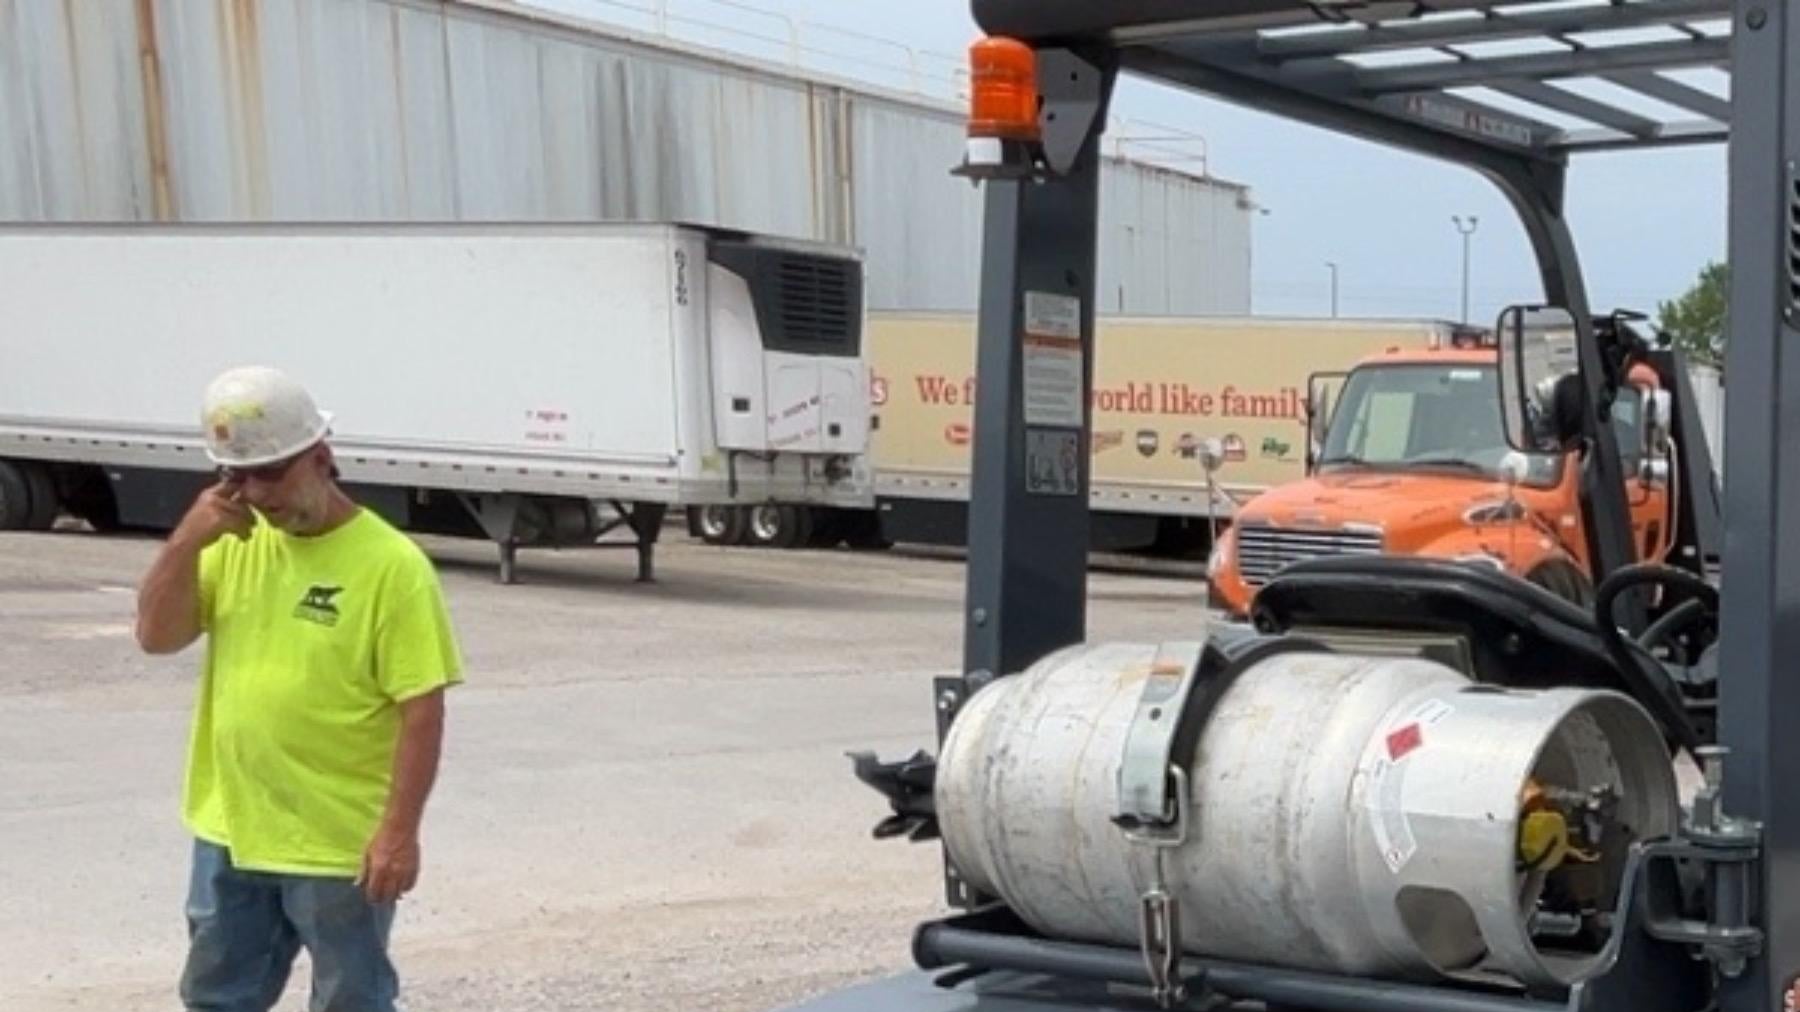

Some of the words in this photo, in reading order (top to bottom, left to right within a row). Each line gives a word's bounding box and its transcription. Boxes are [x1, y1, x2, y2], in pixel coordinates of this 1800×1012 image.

[915, 376, 957, 405] We
[1091, 383, 1153, 413] orld
[1160, 384, 1213, 416] like
